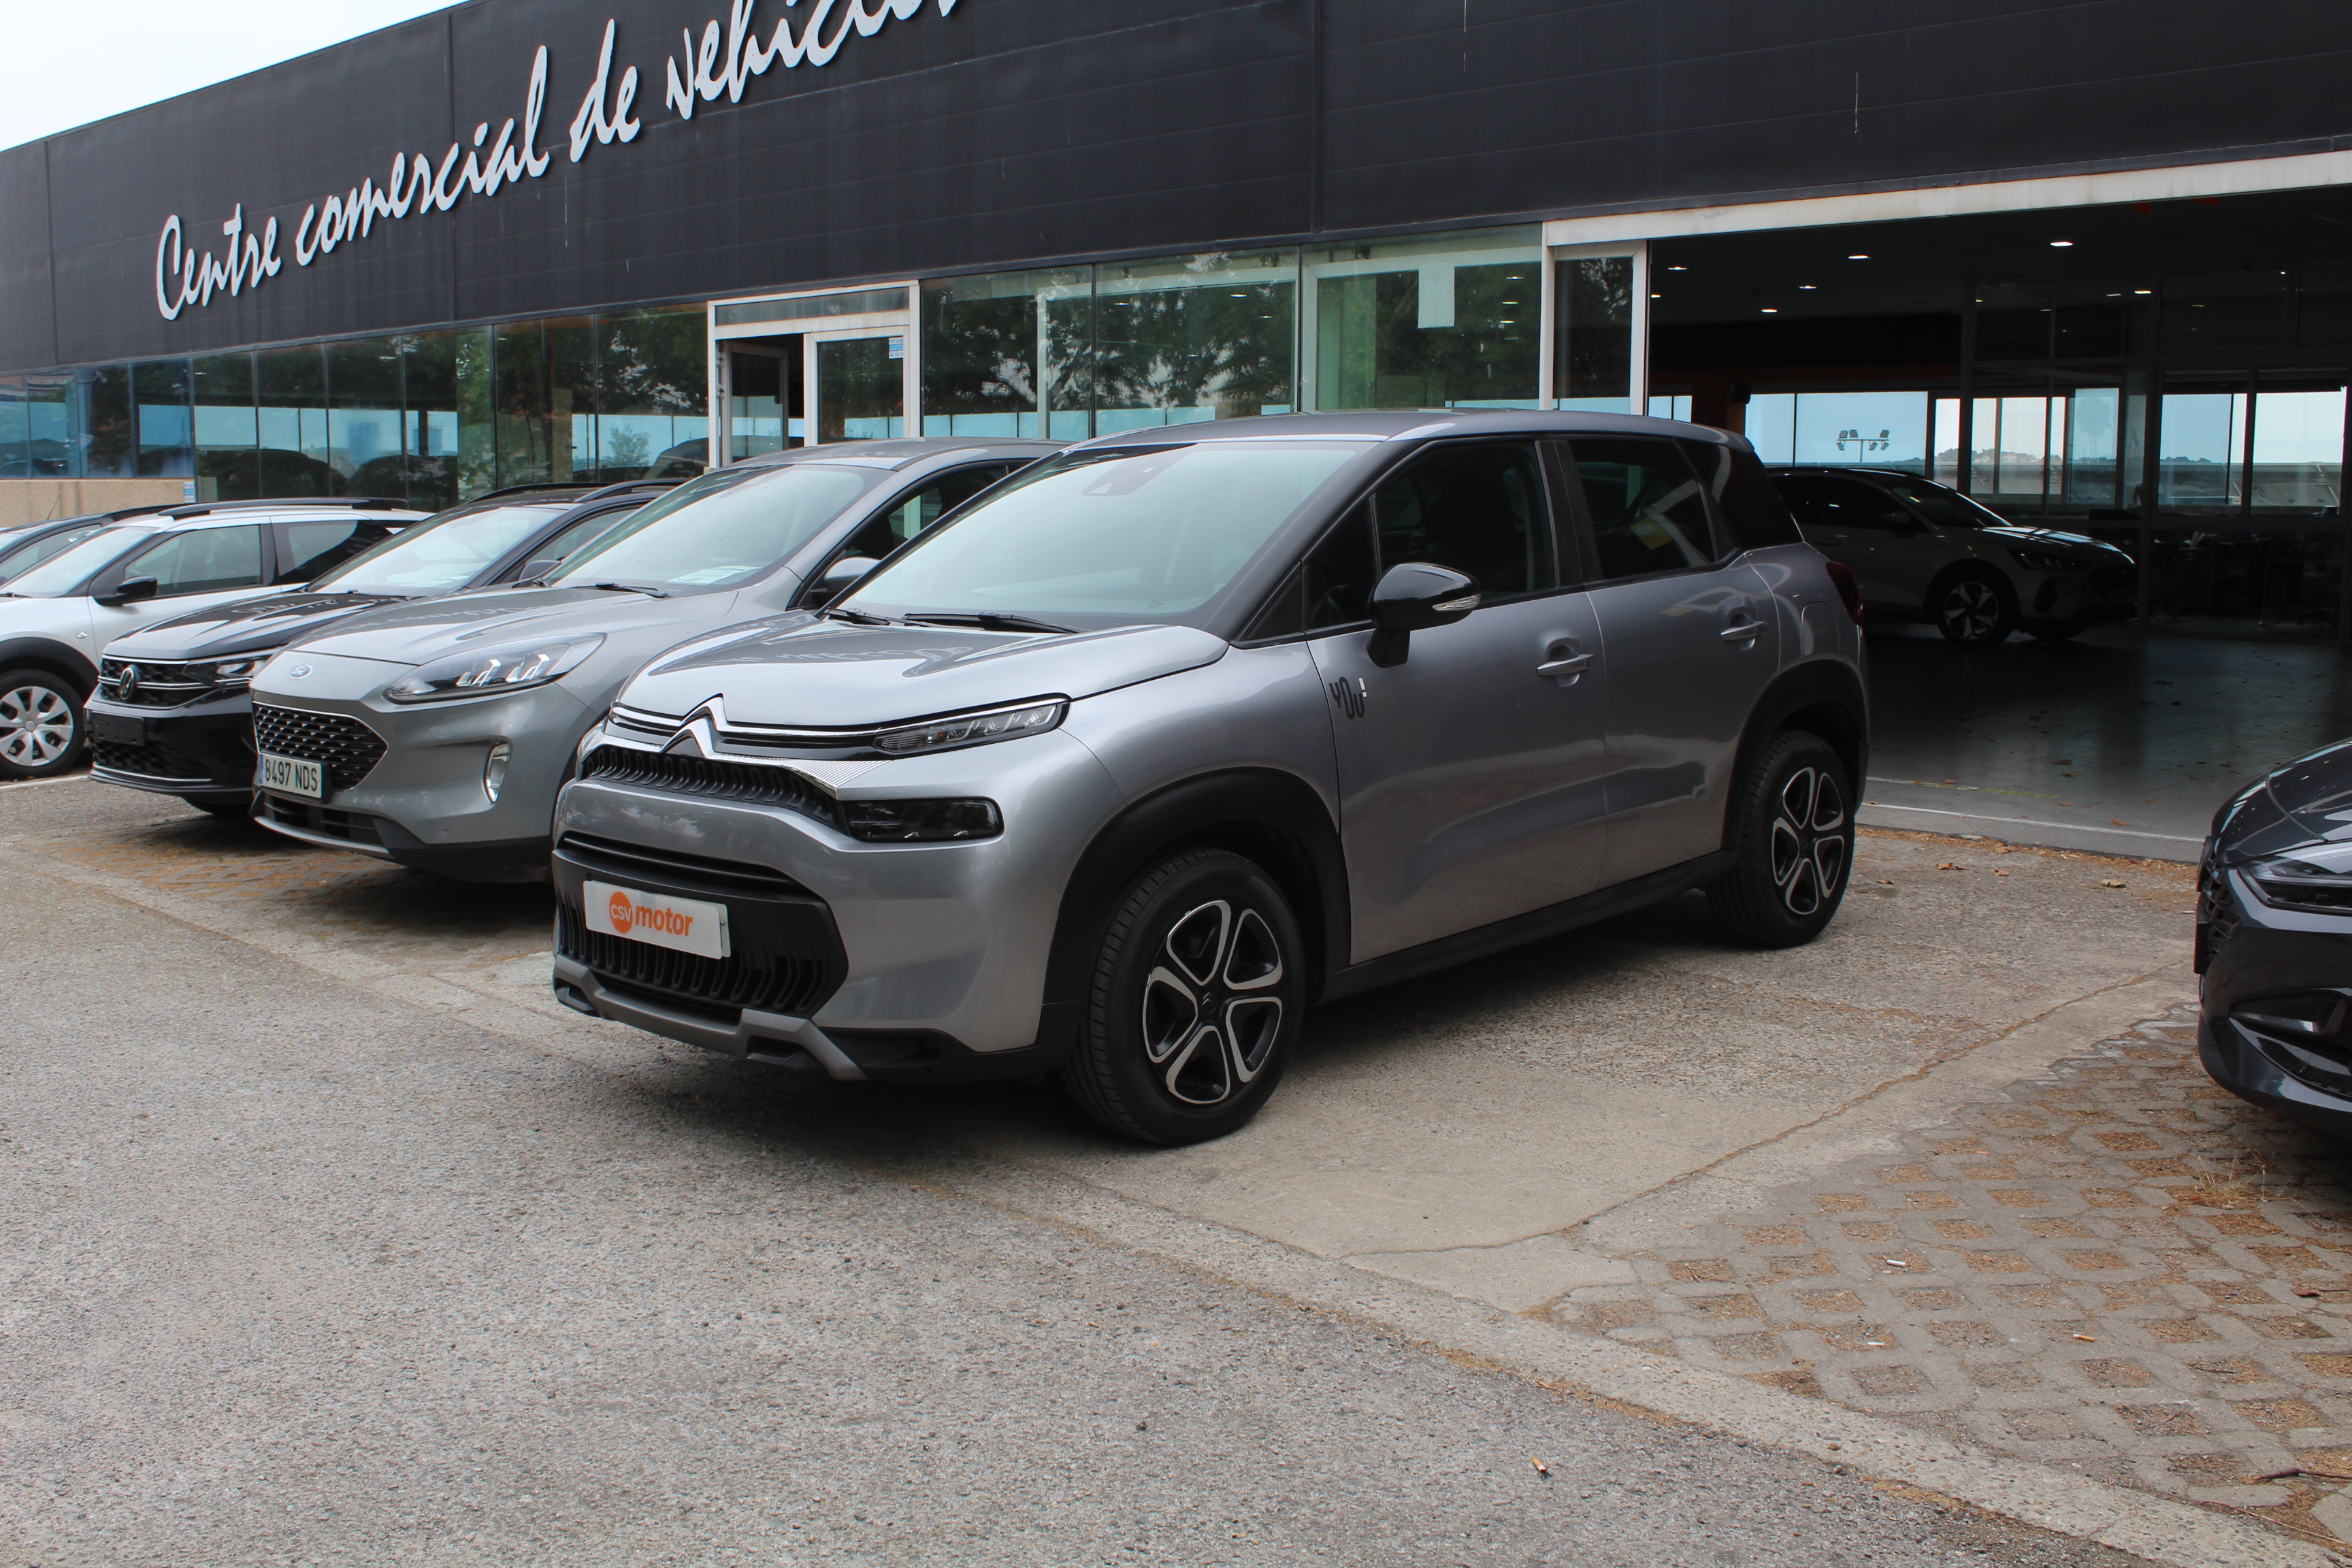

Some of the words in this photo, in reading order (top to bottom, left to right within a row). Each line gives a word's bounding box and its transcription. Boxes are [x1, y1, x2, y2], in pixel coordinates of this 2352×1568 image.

[157, 203, 281, 321] Centre
[295, 45, 549, 266] comercial
[570, 19, 640, 163] de
[265, 758, 291, 786] 8497
[295, 764, 318, 791] NDS
[611, 904, 632, 921] CSV
[635, 905, 693, 936] motor
